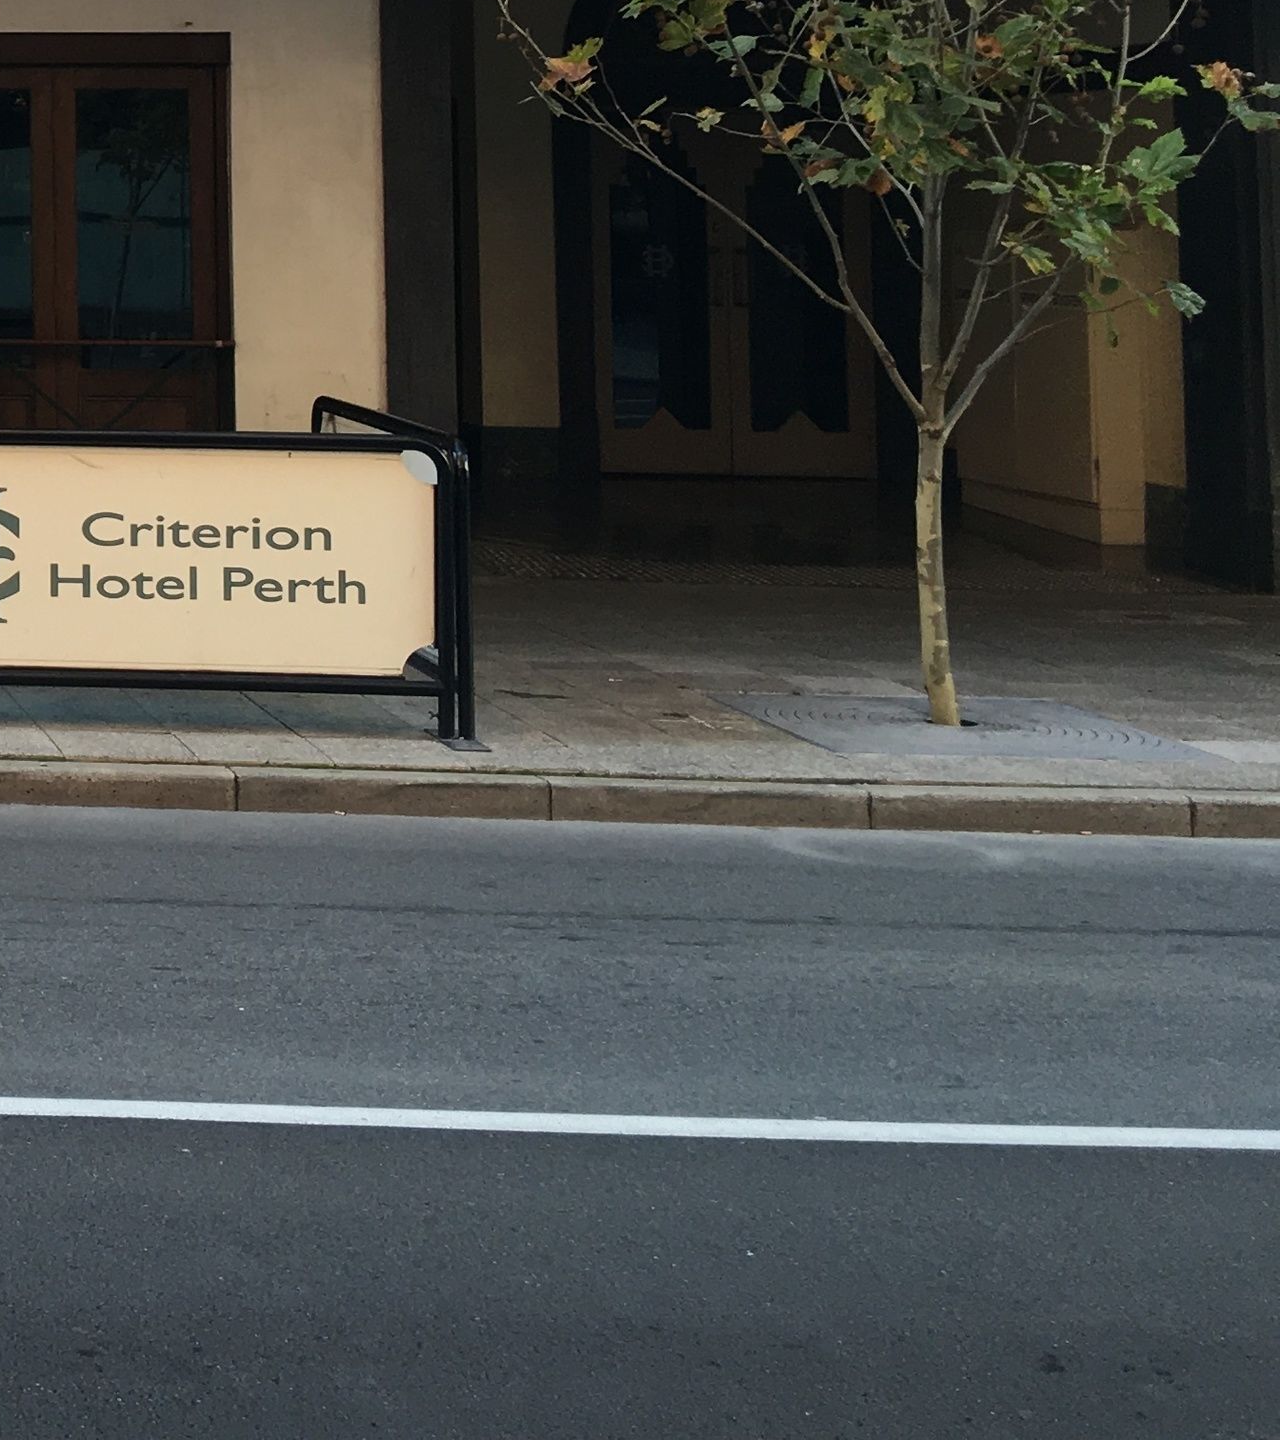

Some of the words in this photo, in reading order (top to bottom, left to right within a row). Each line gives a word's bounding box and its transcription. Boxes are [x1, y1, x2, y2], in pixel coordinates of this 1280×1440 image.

[81, 511, 332, 552] Criterion
[50, 564, 198, 600] Hotel
[223, 566, 366, 605] Perth
